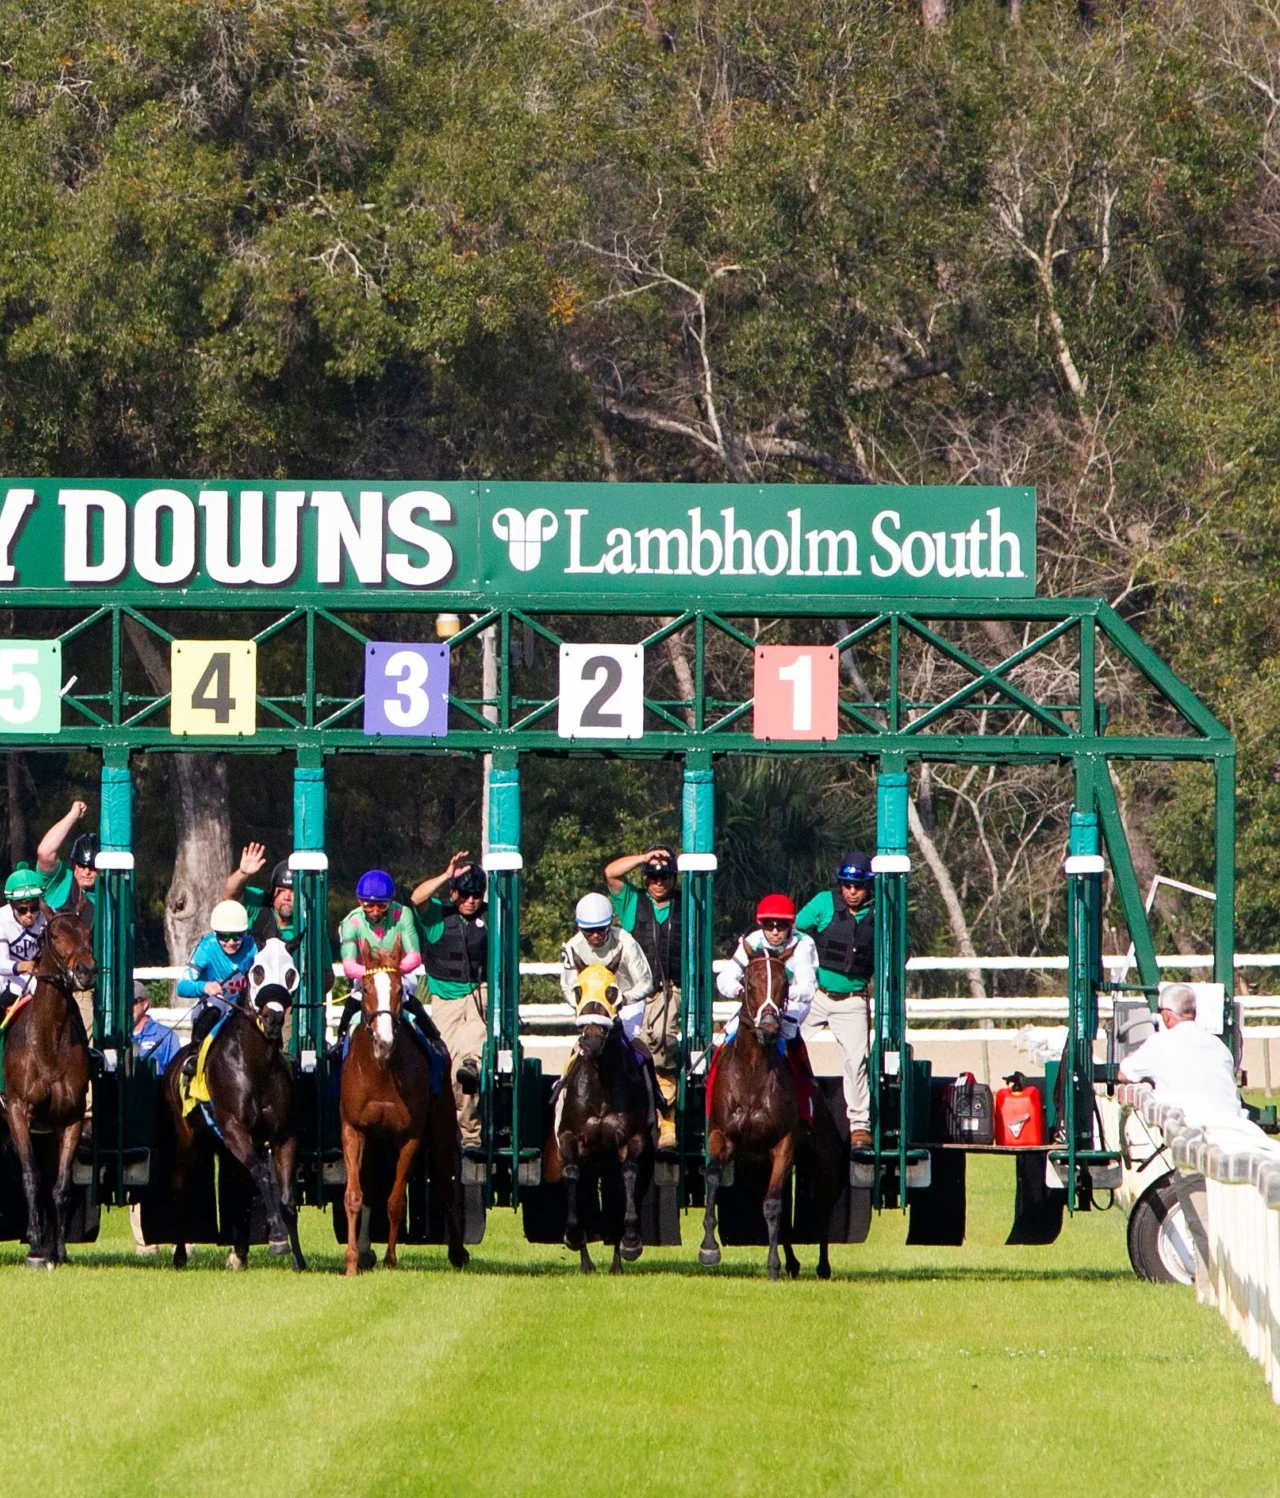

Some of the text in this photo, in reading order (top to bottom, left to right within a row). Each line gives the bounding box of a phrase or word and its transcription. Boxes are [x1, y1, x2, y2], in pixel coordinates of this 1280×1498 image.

[58, 489, 454, 586] DOWNS
[564, 506, 1024, 578] Lambholm South
[190, 653, 237, 724] 4
[383, 651, 430, 728] 3
[580, 655, 623, 727] 2
[778, 655, 813, 731] 1
